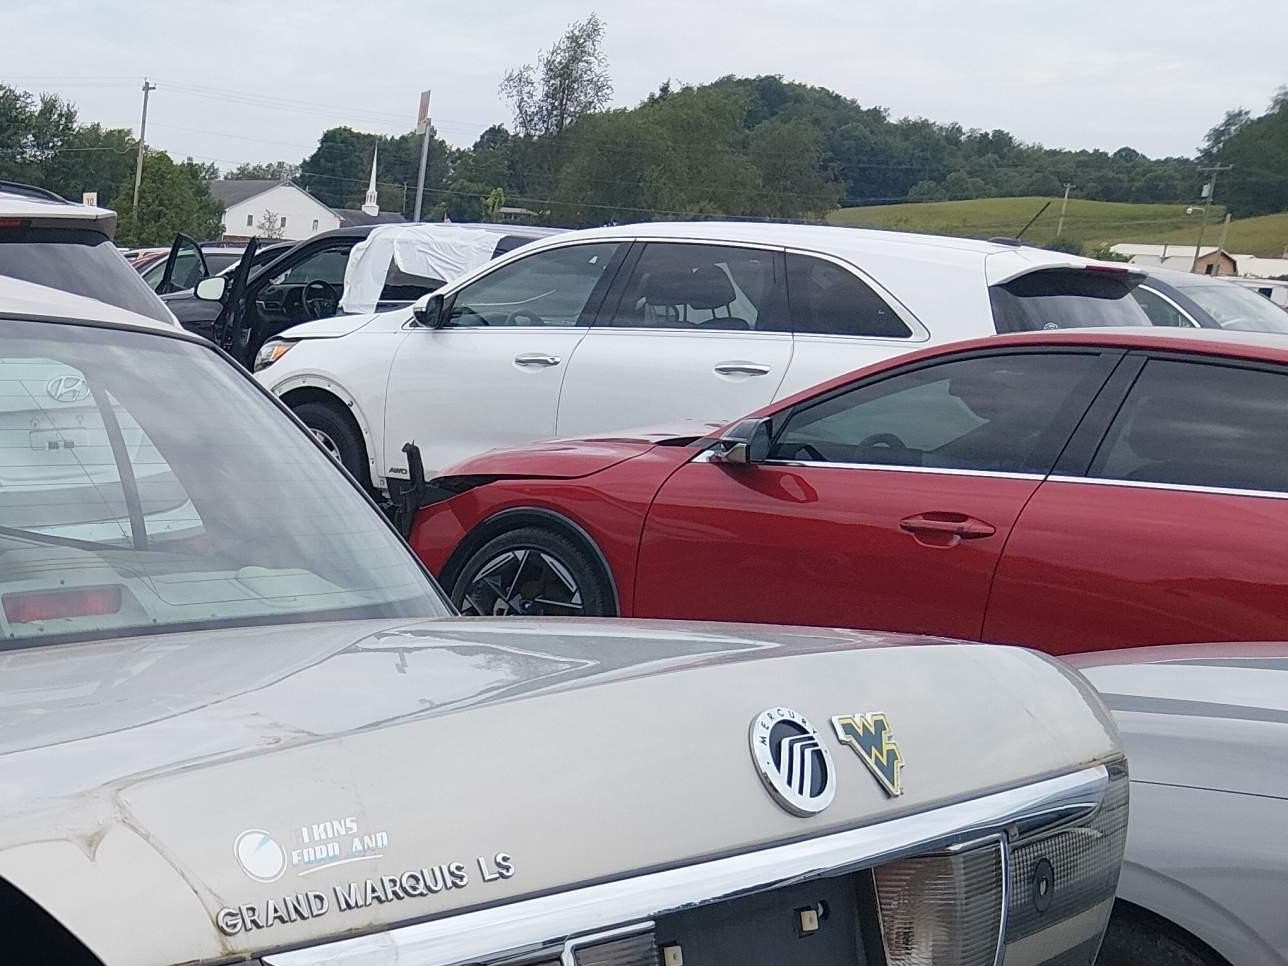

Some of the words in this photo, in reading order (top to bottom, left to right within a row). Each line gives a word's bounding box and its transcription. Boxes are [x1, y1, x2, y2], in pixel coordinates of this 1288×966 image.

[217, 890, 330, 935] GRAND
[333, 860, 469, 912] MARQUIS
[476, 852, 516, 883] LS
